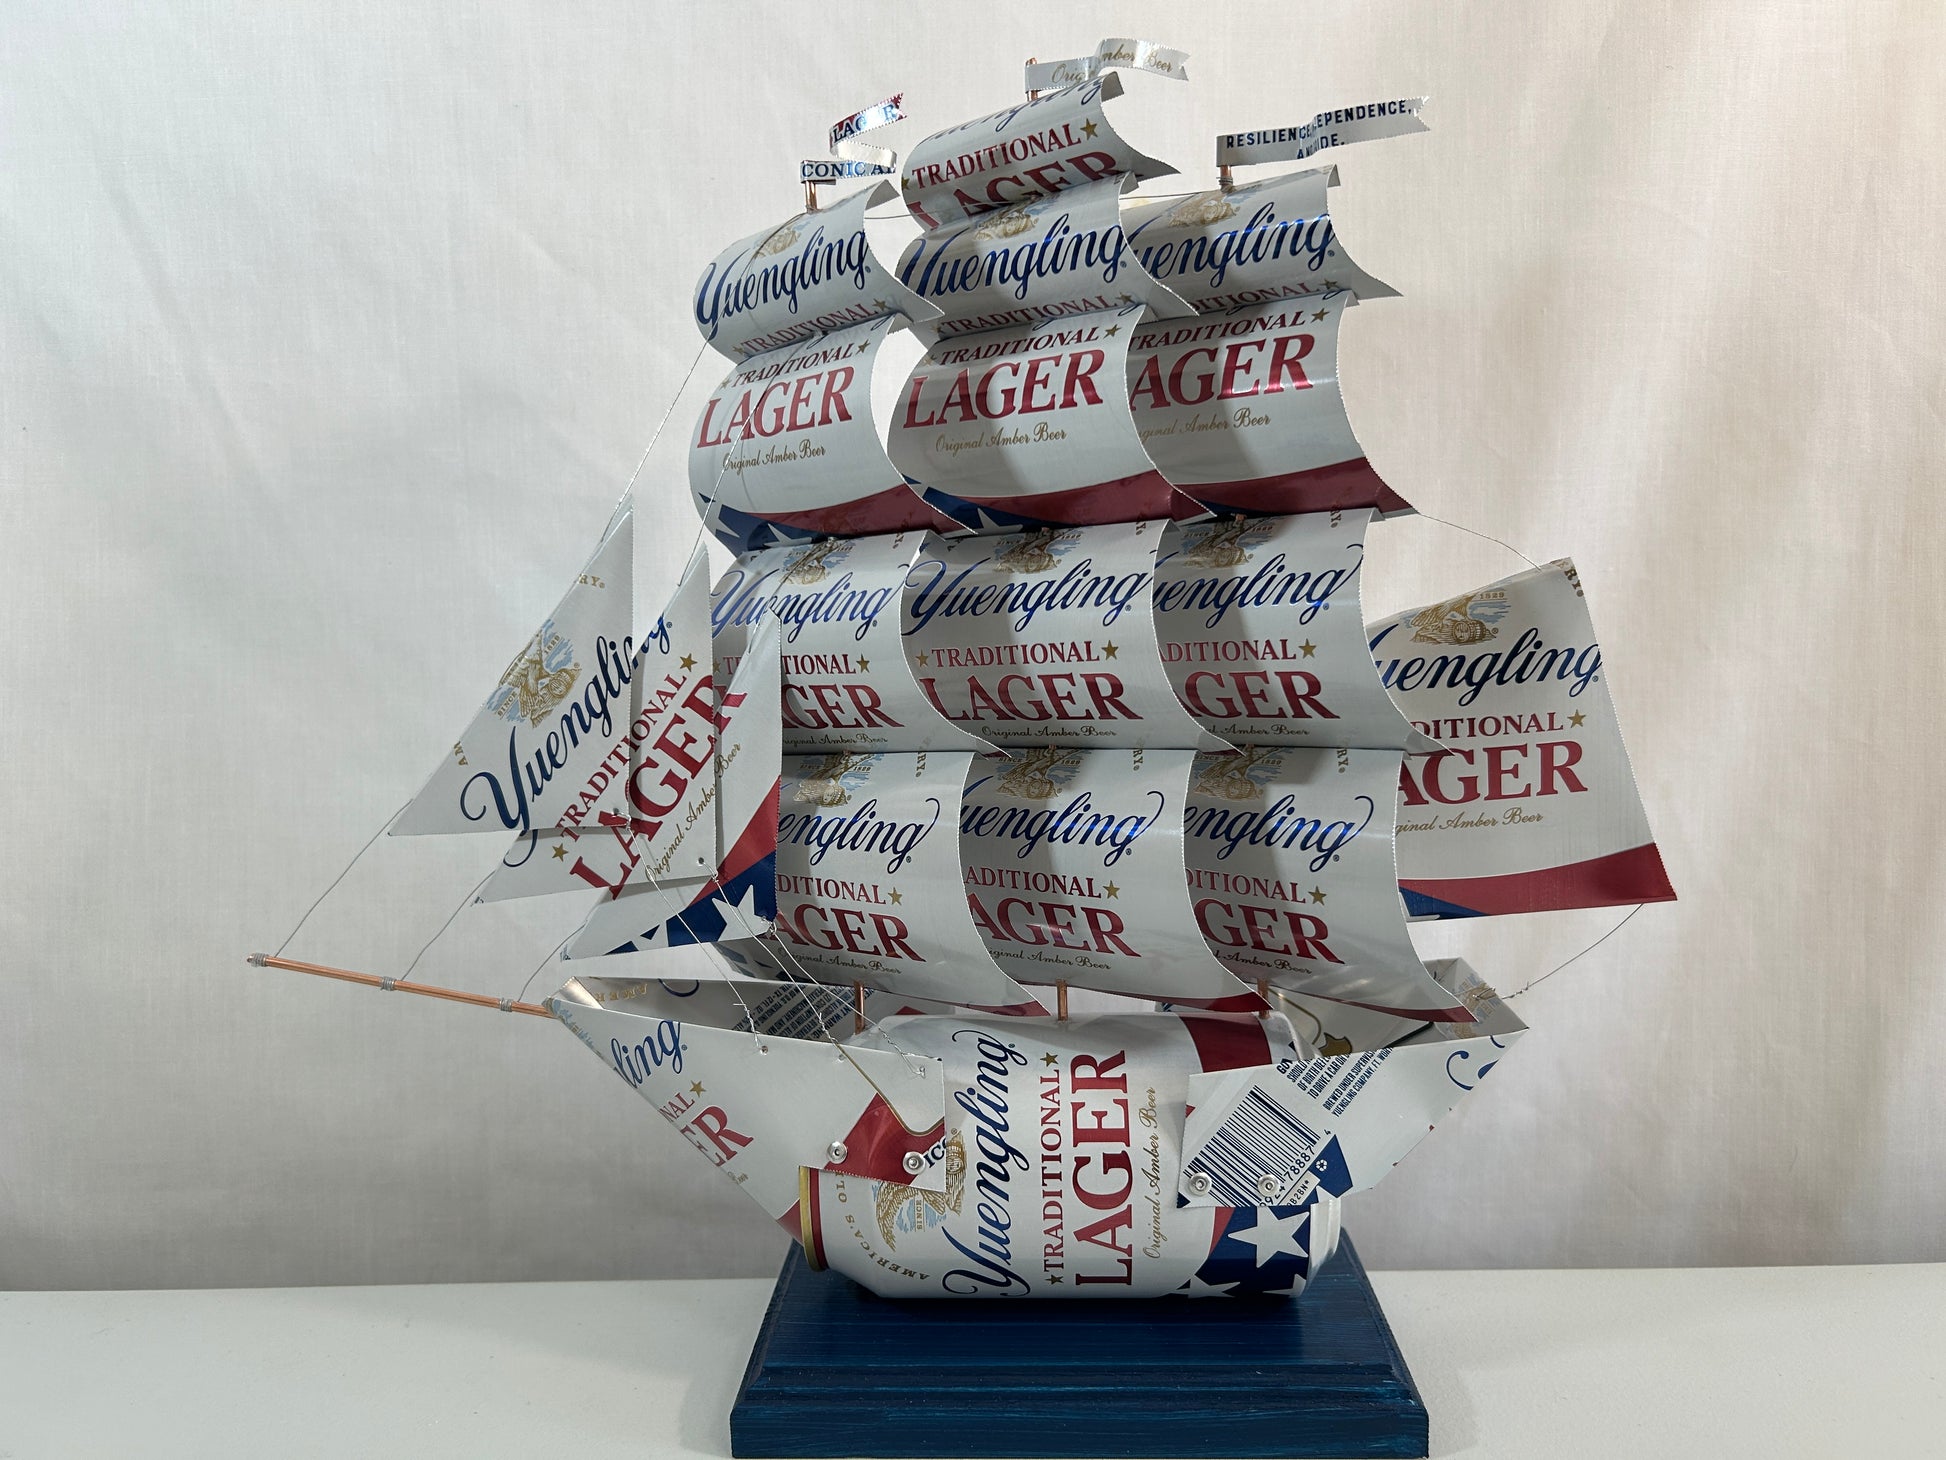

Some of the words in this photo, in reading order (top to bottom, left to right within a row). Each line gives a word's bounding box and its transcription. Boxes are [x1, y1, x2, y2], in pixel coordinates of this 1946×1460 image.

[832, 104, 898, 144] LAGR
[912, 124, 1081, 189] TRADITIONAL
[697, 225, 868, 341] Yuengling
[741, 303, 878, 355] TRADITIONAL
[942, 295, 1118, 334] TRADITIONAL
[732, 343, 855, 388] TRADITIONAL
[939, 327, 1100, 365] TRADITIONAL
[903, 349, 1105, 429] LAGER
[1130, 333, 1315, 410] AGER
[697, 366, 855, 448] LAGER
[1179, 413, 1229, 434] Amber
[1233, 407, 1271, 428] Beer
[762, 445, 798, 466] Amber
[800, 439, 826, 458] Beer
[935, 433, 983, 457] Original
[986, 426, 1030, 448] Amber
[1033, 421, 1067, 442] Beer
[901, 550, 1153, 635] Yuengling
[932, 641, 1100, 667] TRADITIONAL
[1371, 626, 1603, 707] uengling
[919, 672, 1144, 721] LAGER
[982, 726, 1032, 739] Original
[1034, 726, 1080, 738] Amber
[1081, 725, 1117, 737] Beer
[1271, 723, 1310, 735] Beer
[1411, 711, 1564, 740] DITIONAL
[555, 674, 687, 842] TRADITIONAL
[1398, 740, 1588, 806] AGER
[960, 779, 1165, 867] uengling
[1439, 810, 1498, 831] Amber
[1501, 806, 1543, 825] Beer
[964, 866, 1101, 898] ADITIONAL
[767, 904, 926, 962] AGER
[967, 893, 1141, 958] AGER
[1194, 898, 1345, 964] GER
[1027, 951, 1073, 966] Amber
[1313, 1075, 1329, 1092] DRIVE
[1327, 1061, 1340, 1074] CAR
[1323, 1088, 1342, 1110] BREWED
[1338, 1072, 1355, 1090] UNDER
[1138, 1087, 1157, 1128] Beer
[1332, 1089, 1356, 1116] YUENGLING
[942, 1030, 1030, 1296] Yuengling
[1040, 1069, 1064, 1272] TRADITIONAL
[1070, 1050, 1133, 1286] LAGER
[1140, 1132, 1162, 1194] Amber
[1284, 1145, 1314, 1181] 78887
[1142, 1196, 1167, 1259] Original
